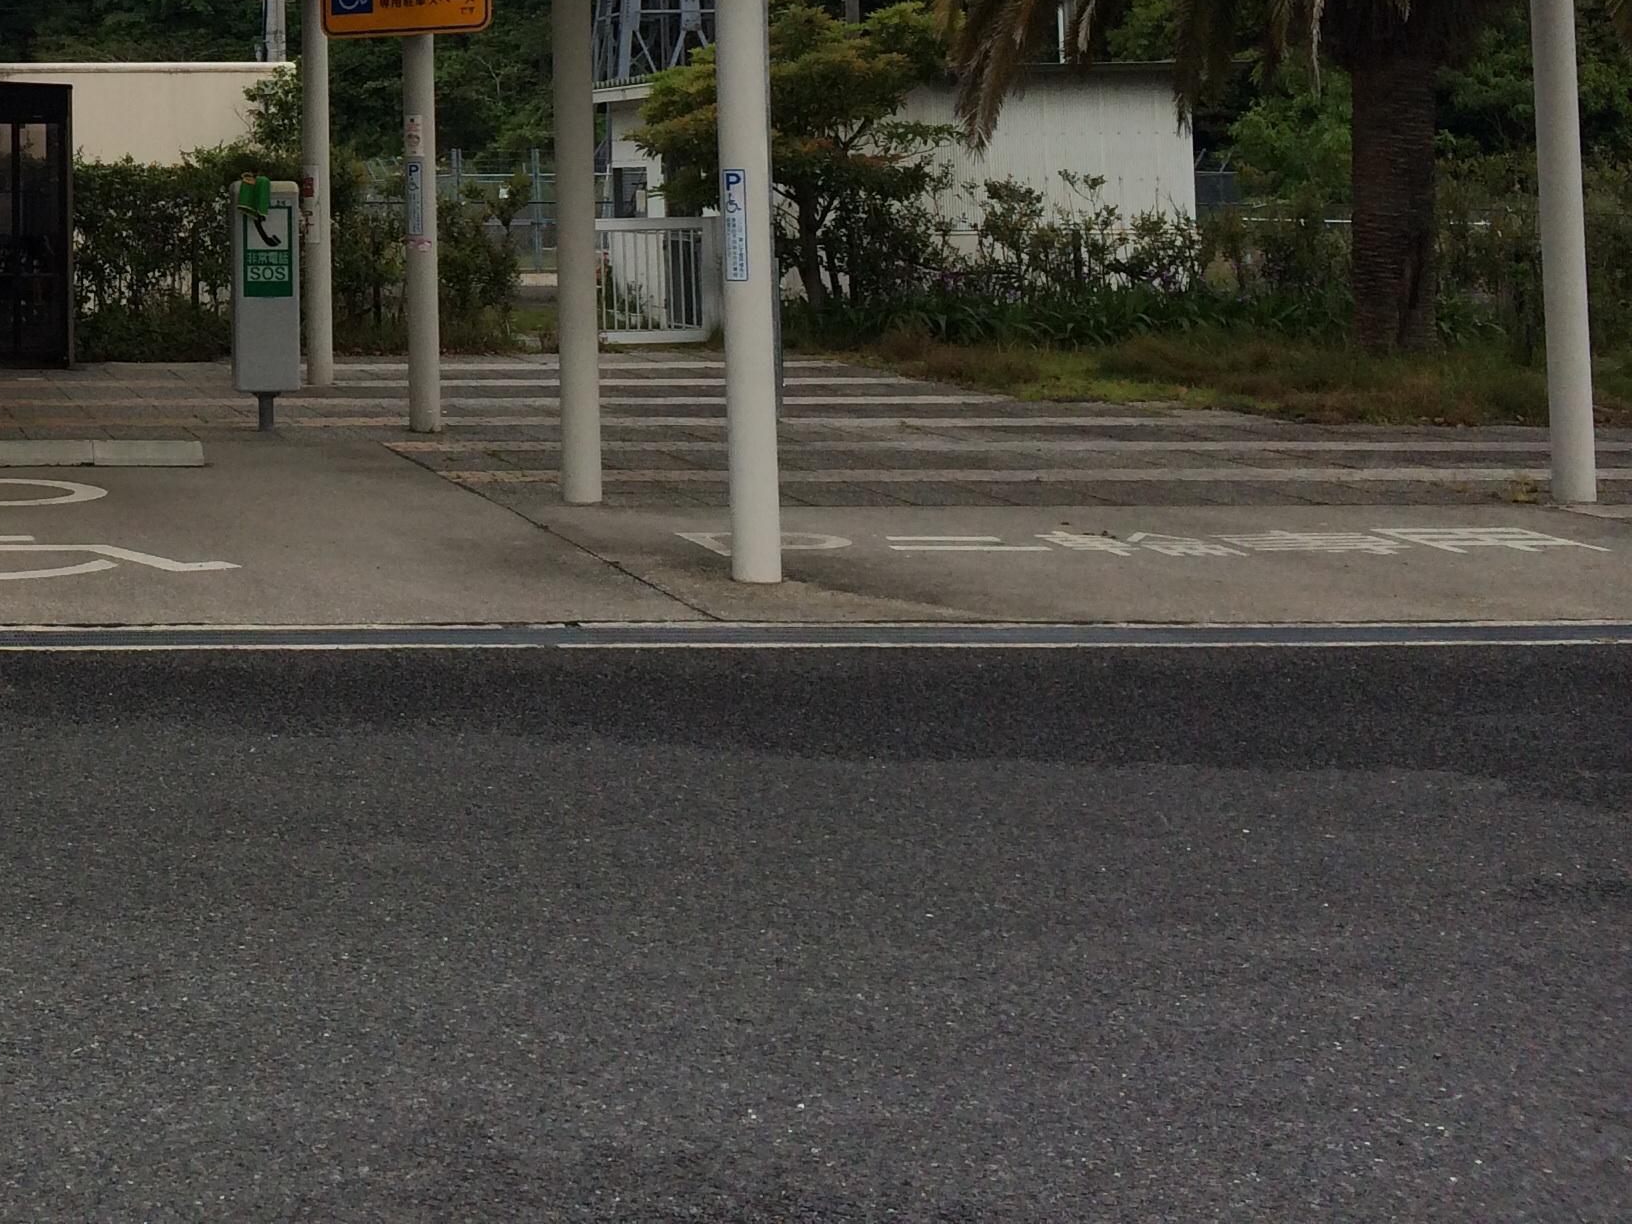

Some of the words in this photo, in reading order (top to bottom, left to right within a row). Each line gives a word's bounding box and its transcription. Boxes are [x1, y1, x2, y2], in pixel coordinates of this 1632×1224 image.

[408, 164, 419, 176] P
[726, 173, 741, 190] P
[246, 251, 289, 265] 非常電話
[250, 266, 286, 281] SOS
